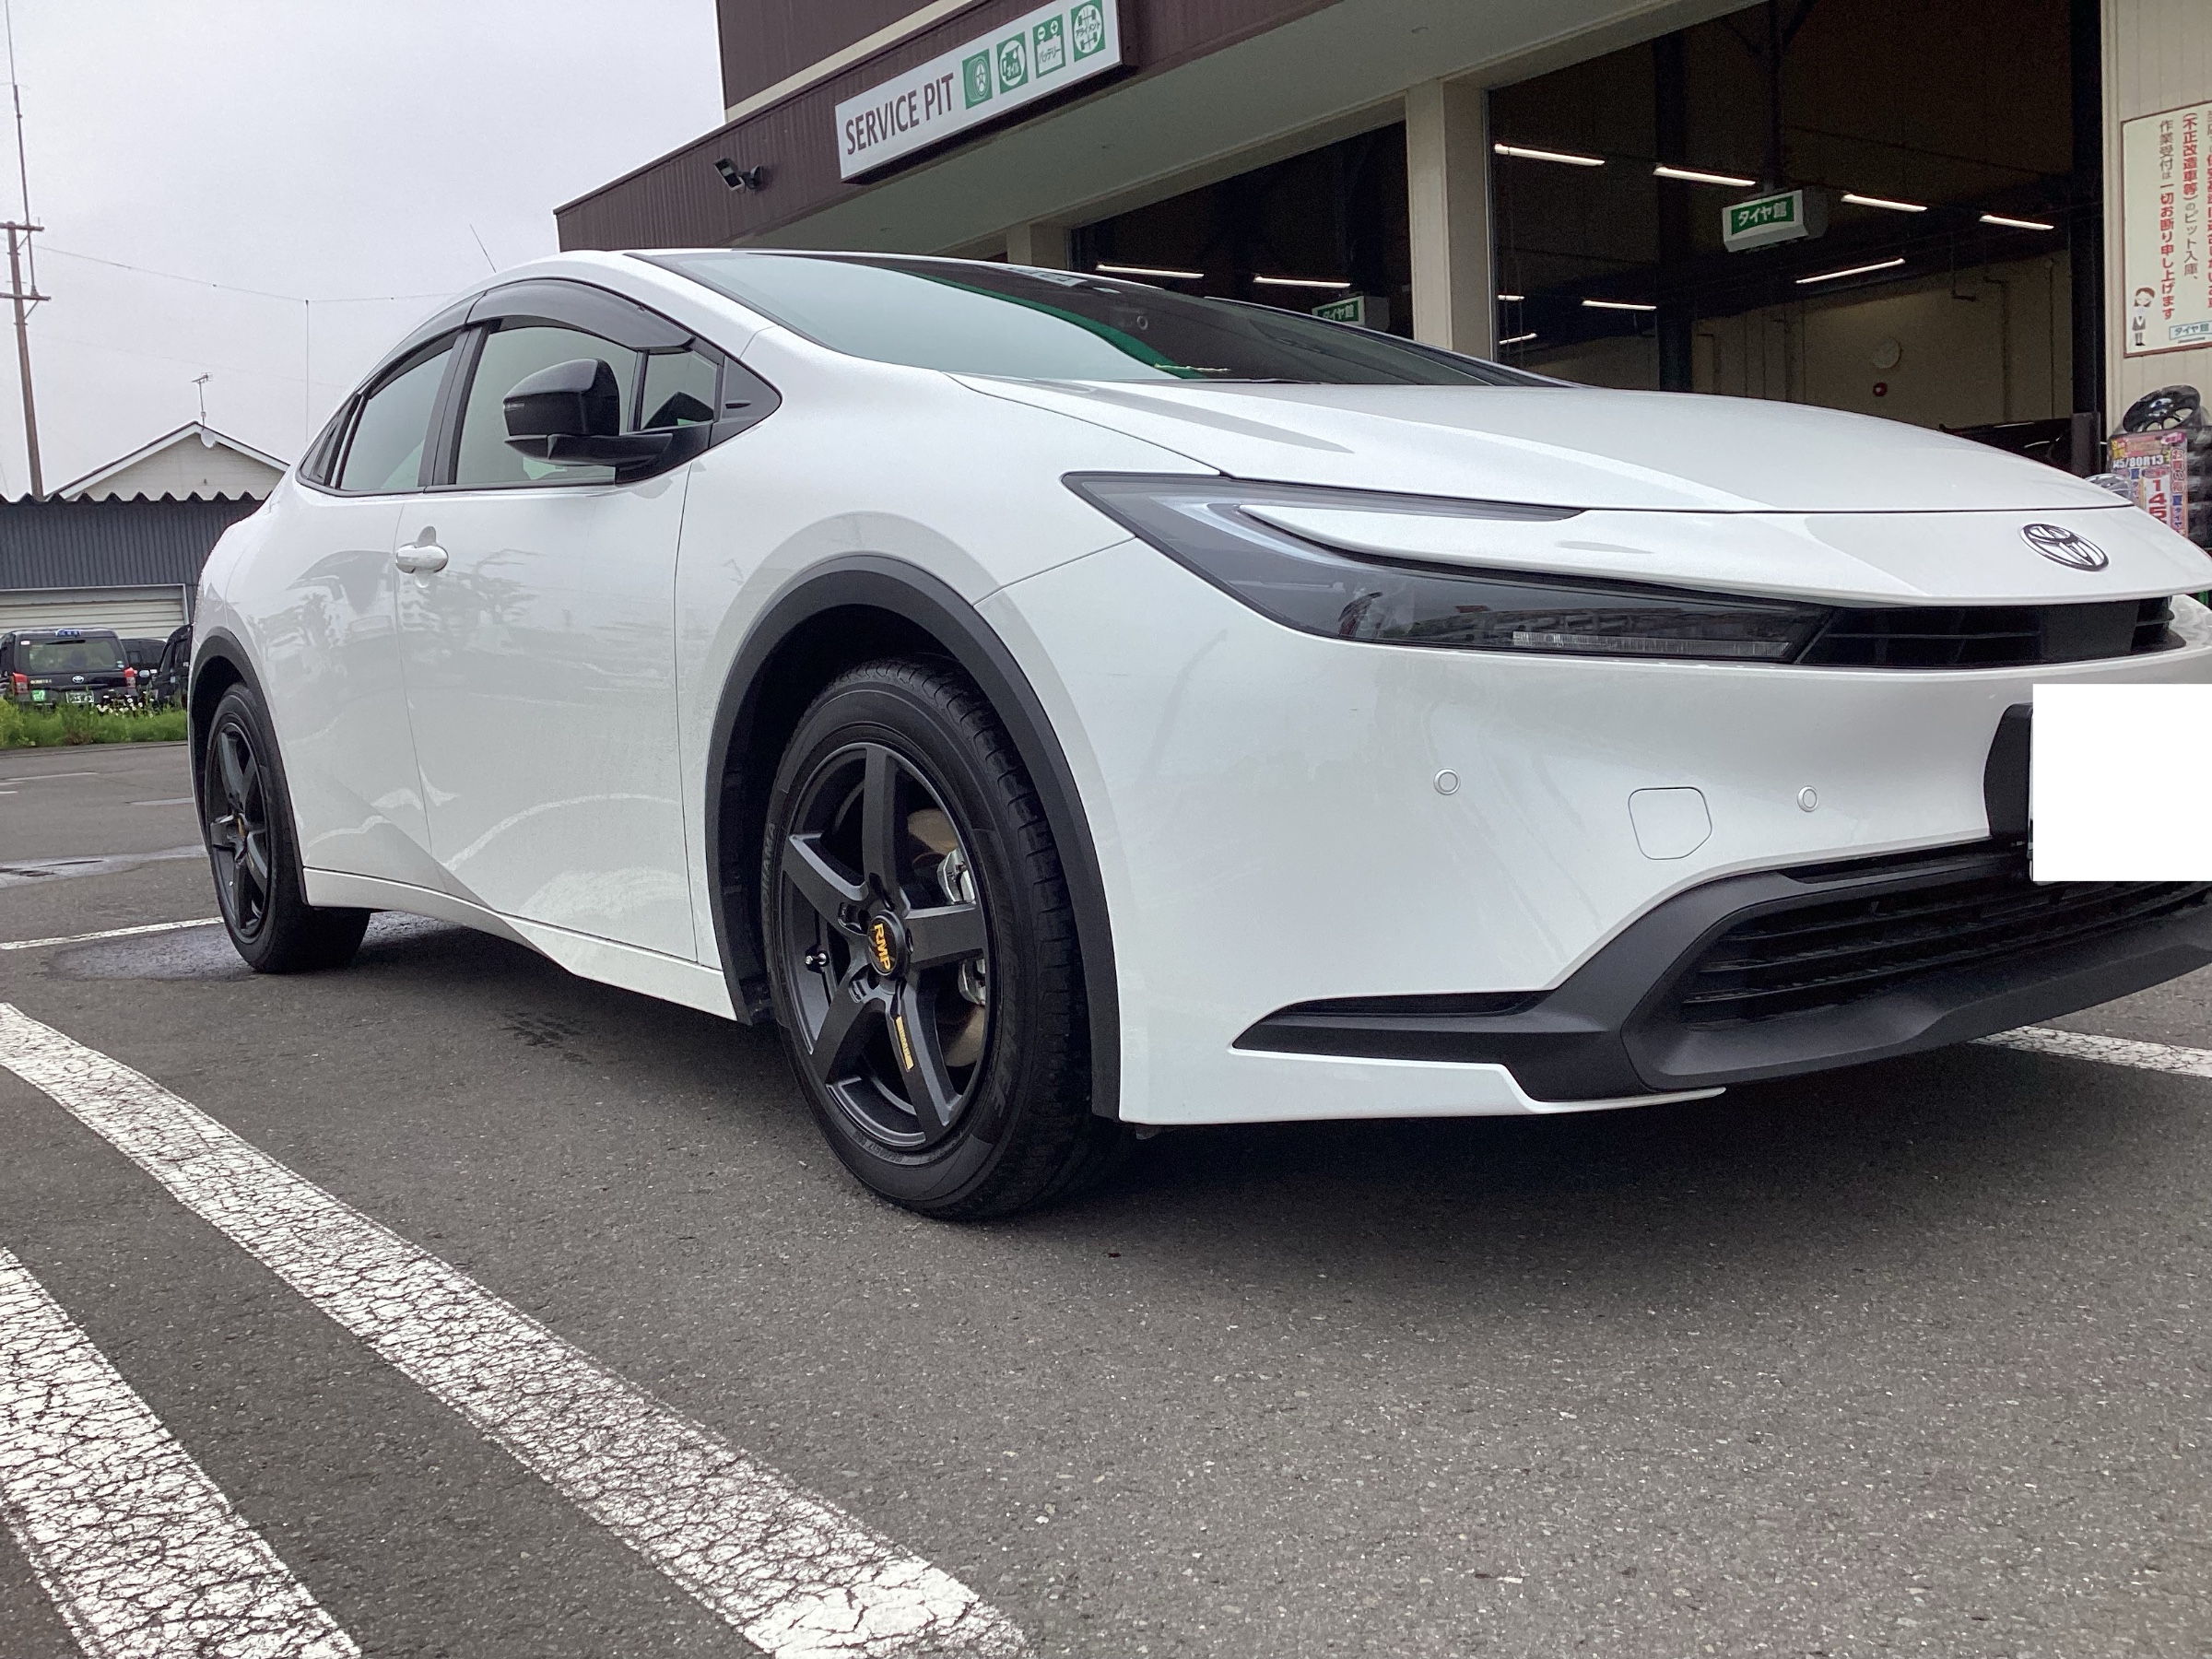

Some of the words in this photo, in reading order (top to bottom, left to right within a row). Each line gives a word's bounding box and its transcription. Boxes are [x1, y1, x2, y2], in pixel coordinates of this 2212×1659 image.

[1039, 46, 1061, 64] バッテリー
[845, 88, 920, 156] SERVICE
[924, 72, 954, 122] PIT
[1738, 201, 1787, 227] タイヤ館
[2175, 323, 2209, 336] タイヤ館
[874, 923, 892, 971] RMP
